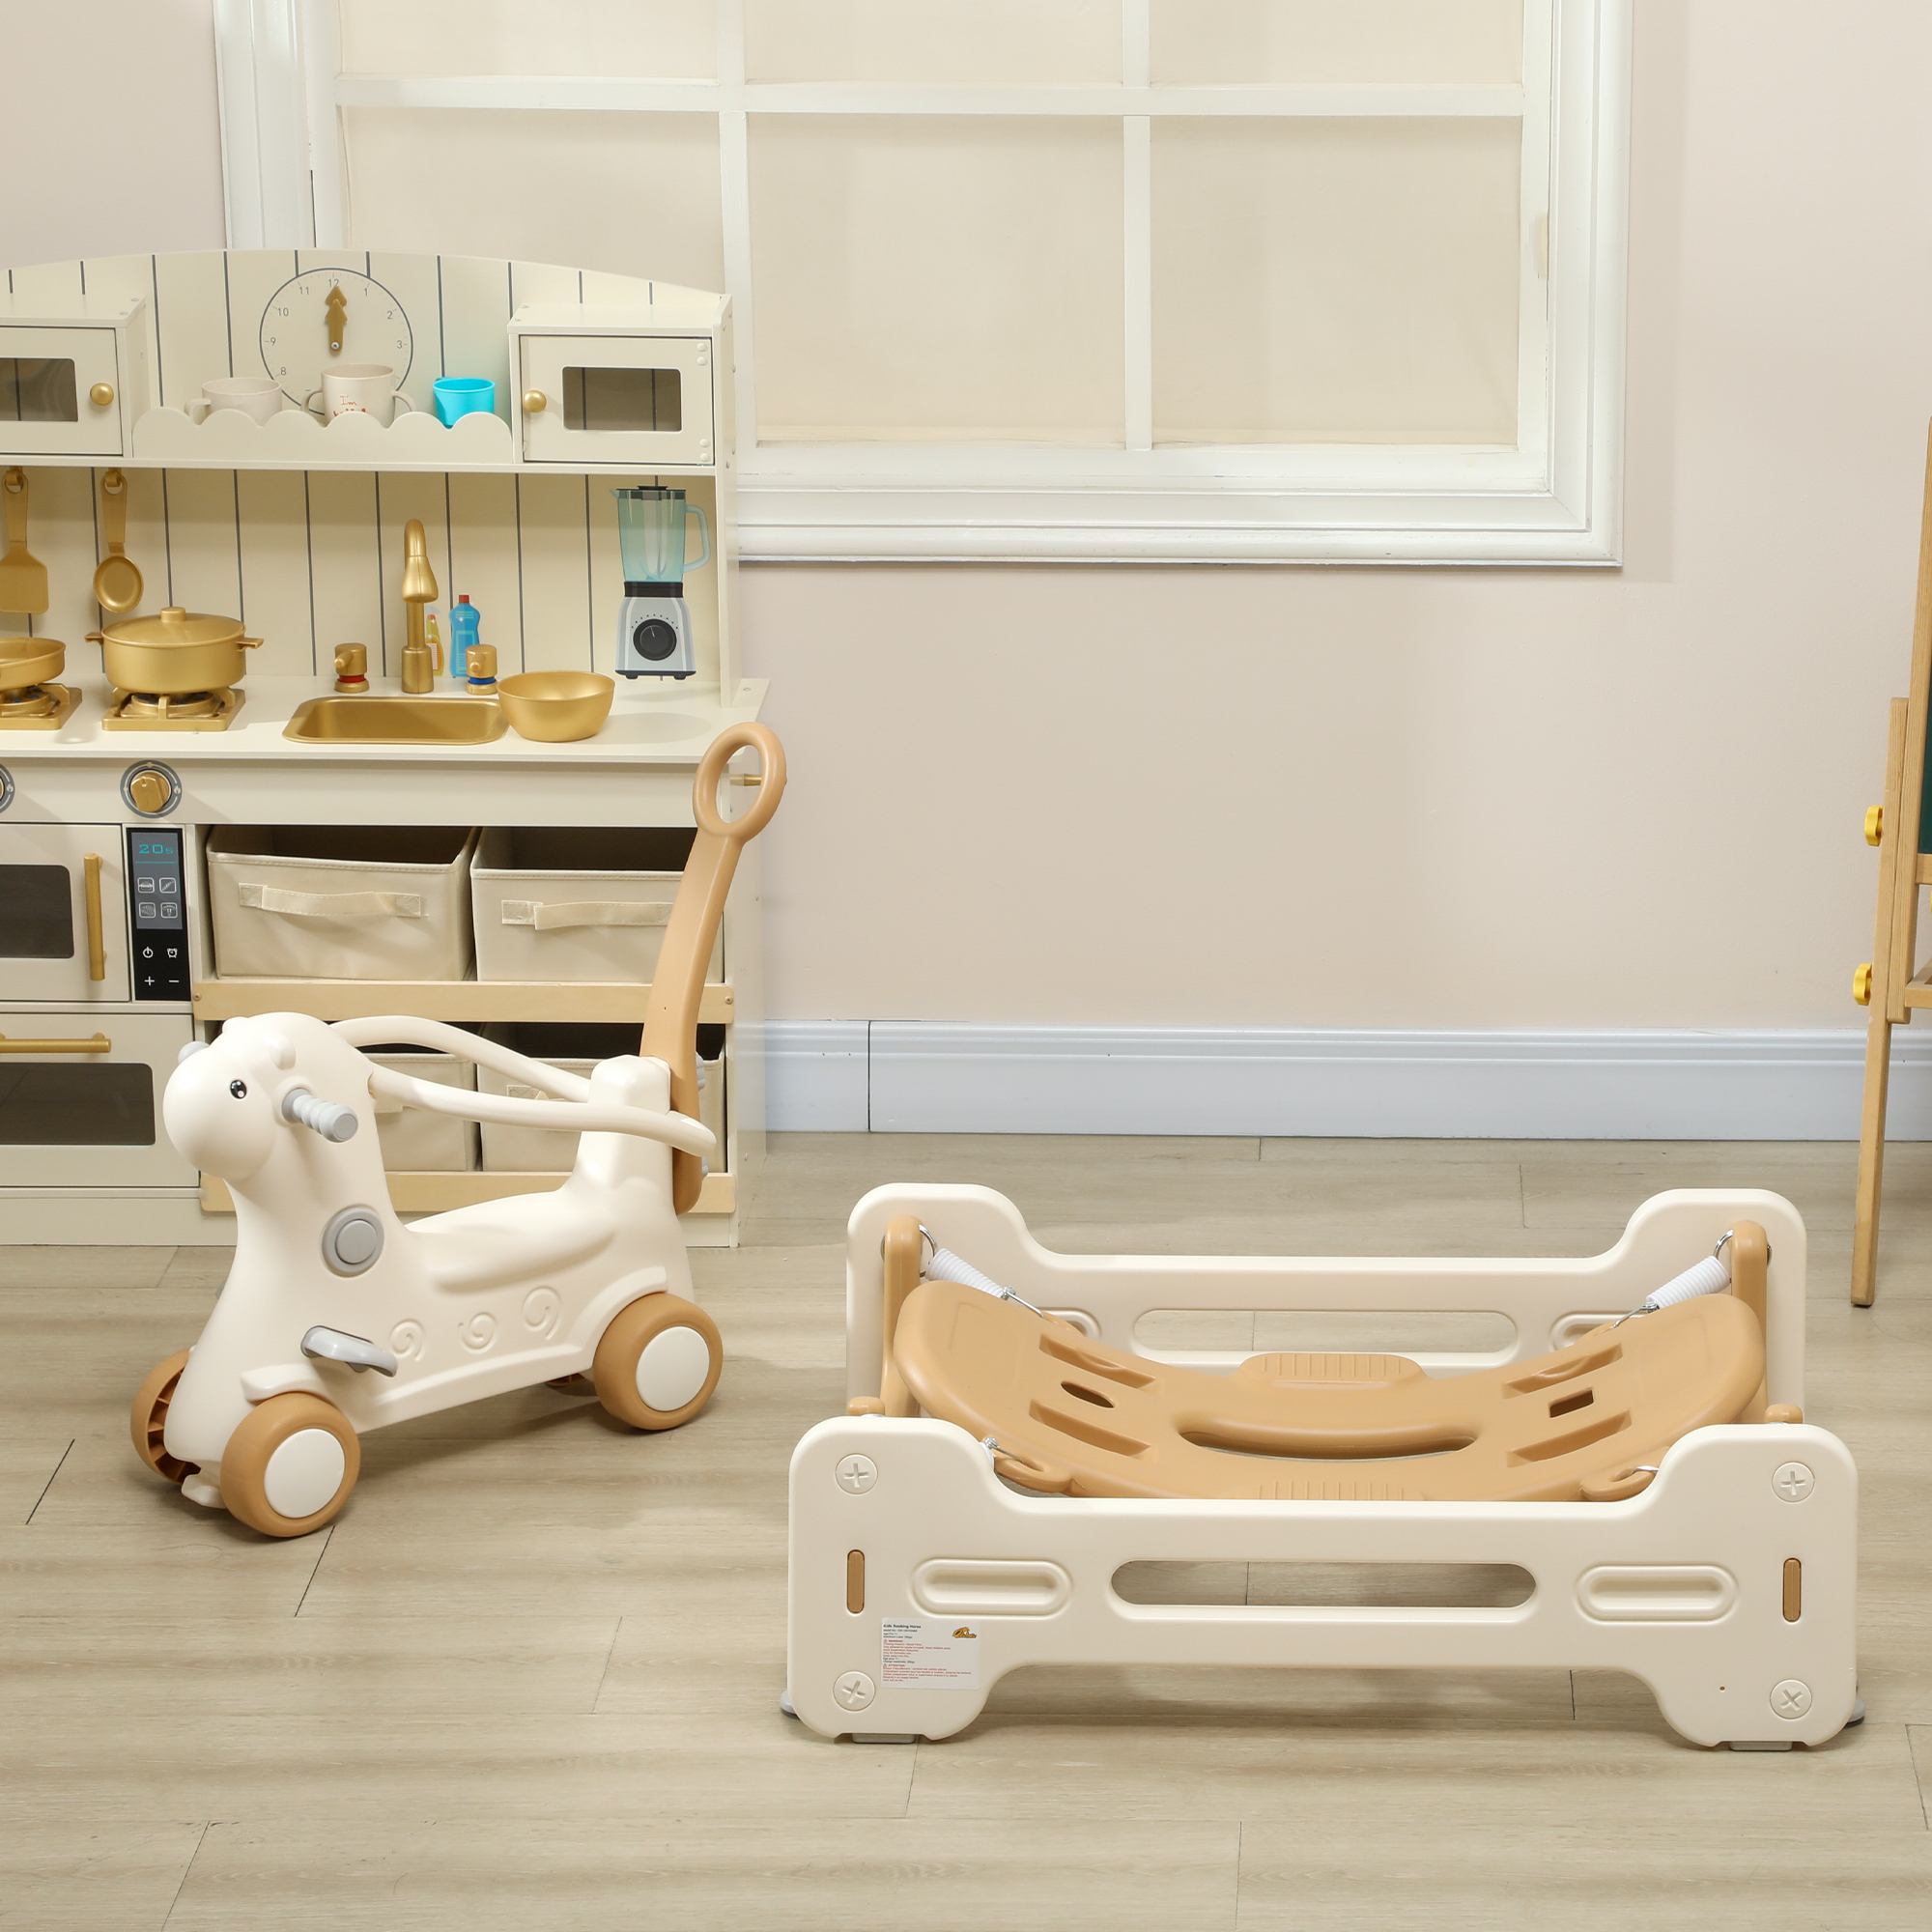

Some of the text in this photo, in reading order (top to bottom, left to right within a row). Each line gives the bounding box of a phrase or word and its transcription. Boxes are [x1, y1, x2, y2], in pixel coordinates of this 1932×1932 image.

[328, 278, 340, 287] 12
[299, 286, 309, 295] 11
[277, 307, 289, 317] 10
[386, 310, 393, 320] 2
[270, 337, 276, 346] 9
[396, 340, 403, 349] 3
[280, 367, 287, 376] 8
[339, 394, 358, 406] I'm
